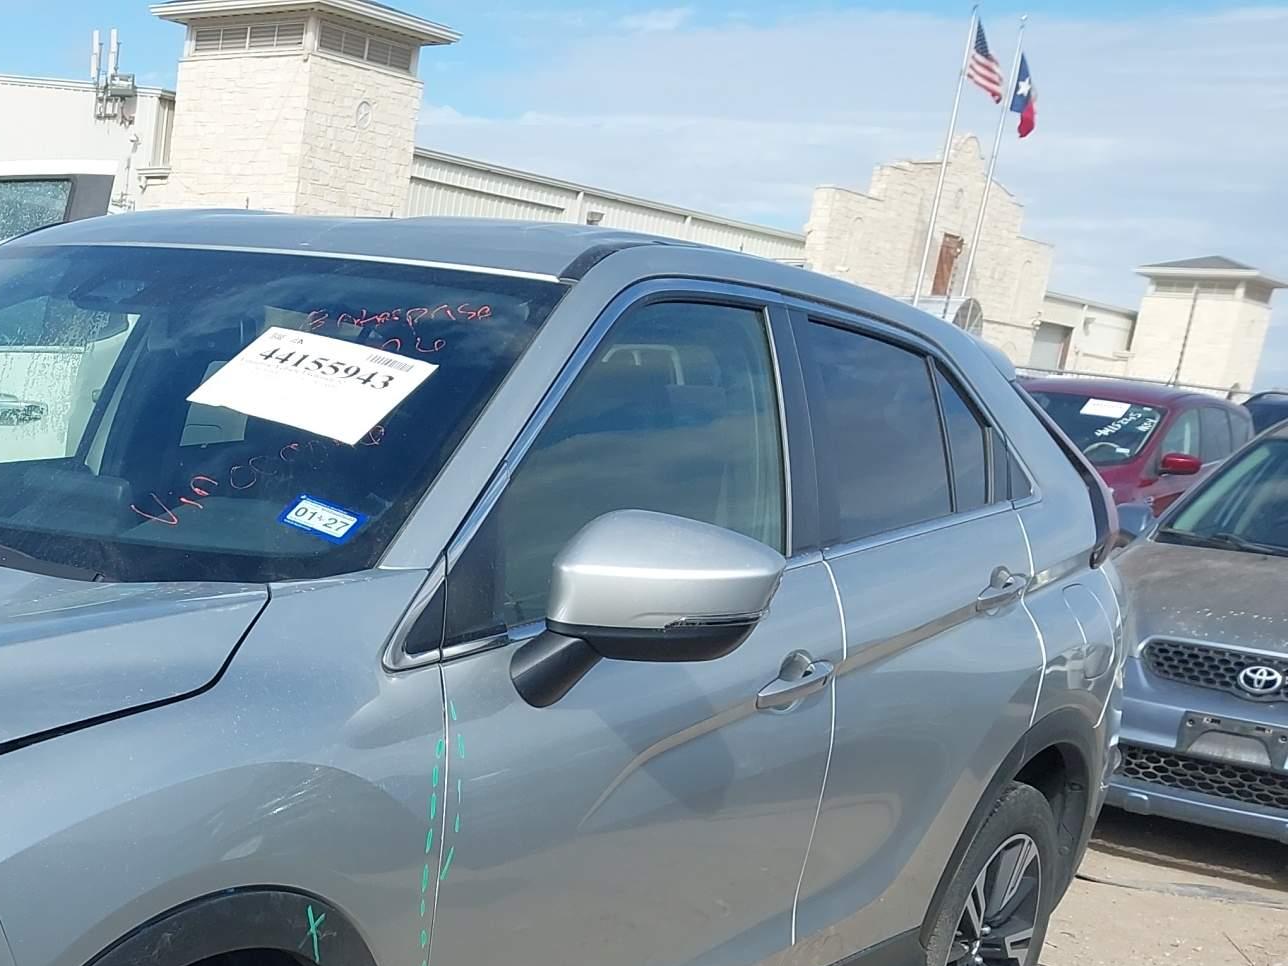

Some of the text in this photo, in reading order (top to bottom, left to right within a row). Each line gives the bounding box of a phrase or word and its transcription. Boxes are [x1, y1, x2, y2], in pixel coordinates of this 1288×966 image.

[259, 347, 394, 390] 44155943
[294, 506, 318, 521] 01
[322, 517, 350, 532] 27
